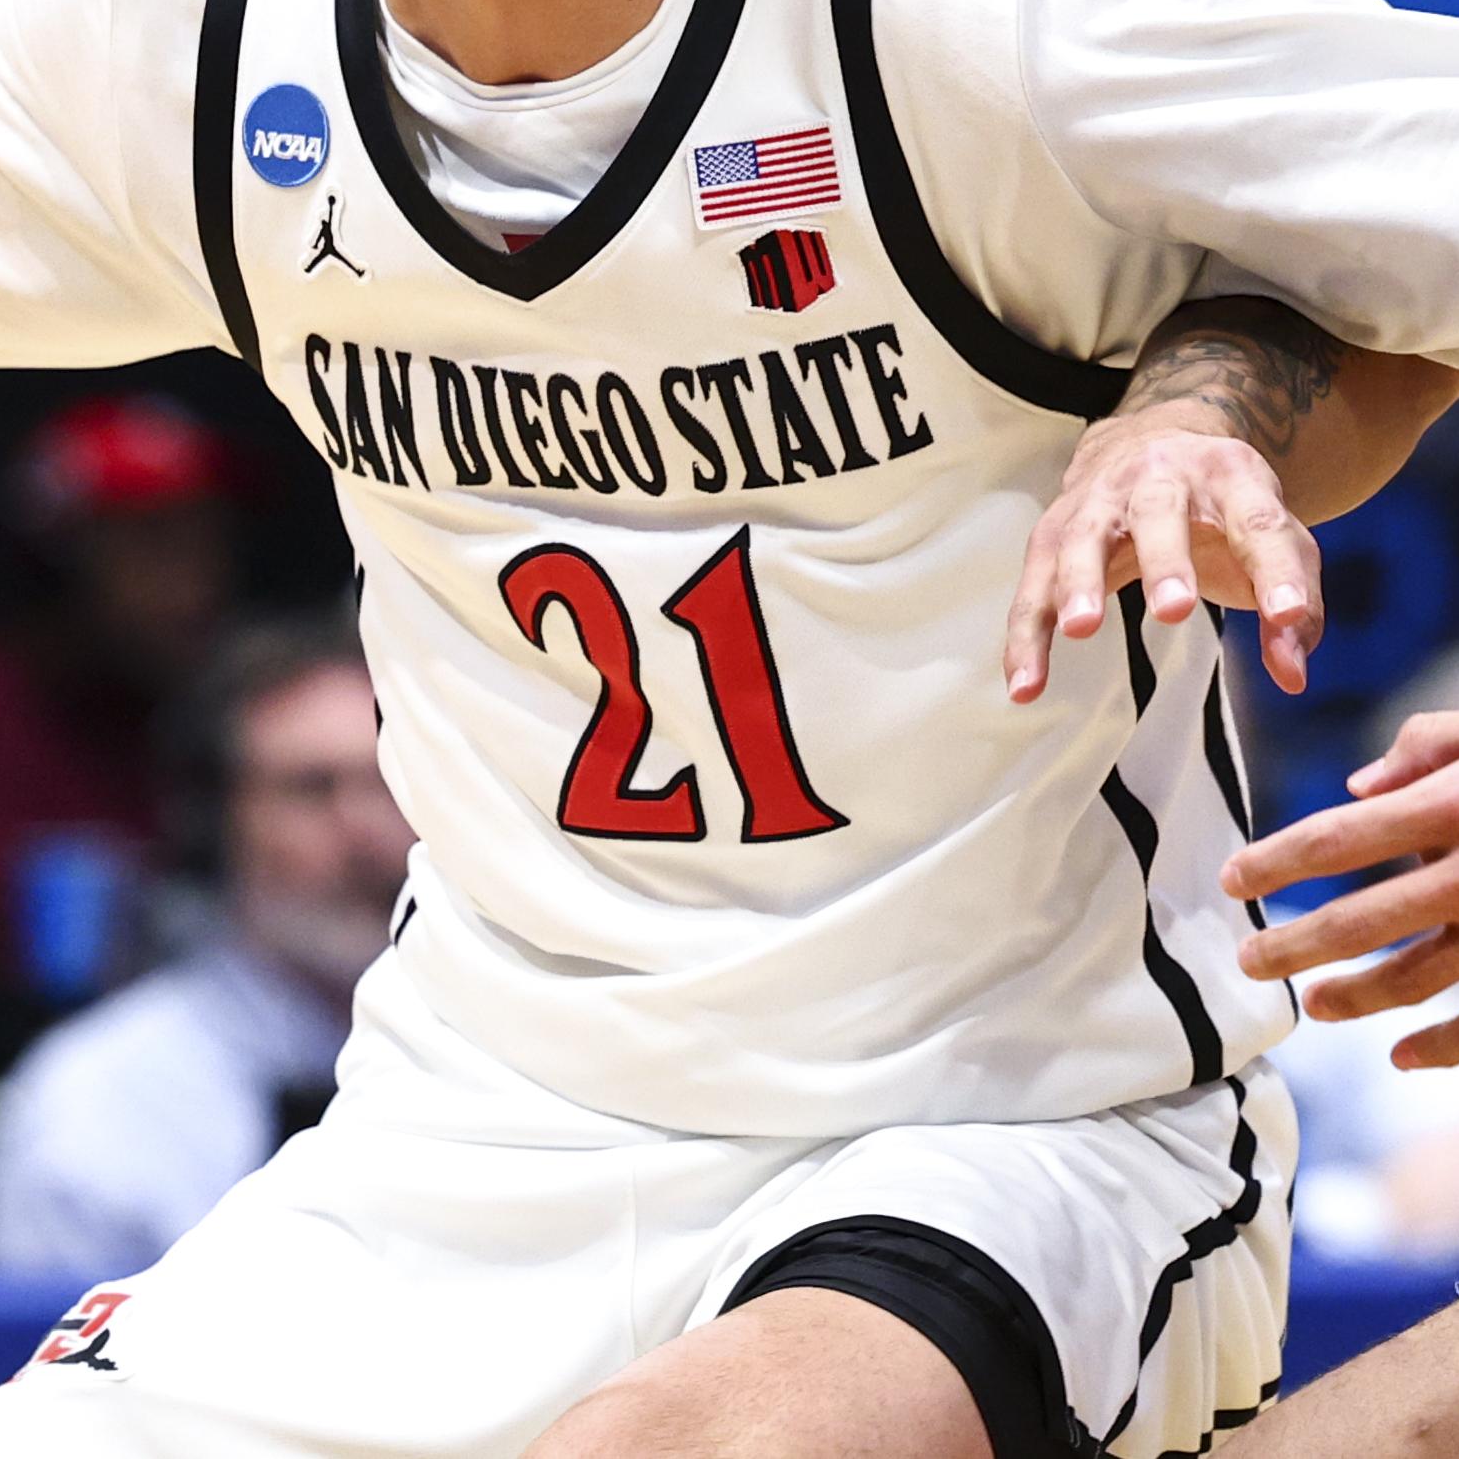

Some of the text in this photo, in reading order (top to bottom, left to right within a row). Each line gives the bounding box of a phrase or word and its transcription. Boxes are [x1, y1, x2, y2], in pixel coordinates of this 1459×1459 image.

[252, 128, 323, 164] NCAA
[305, 323, 935, 497] SAN DIEGO STATE
[497, 523, 852, 845] 21
